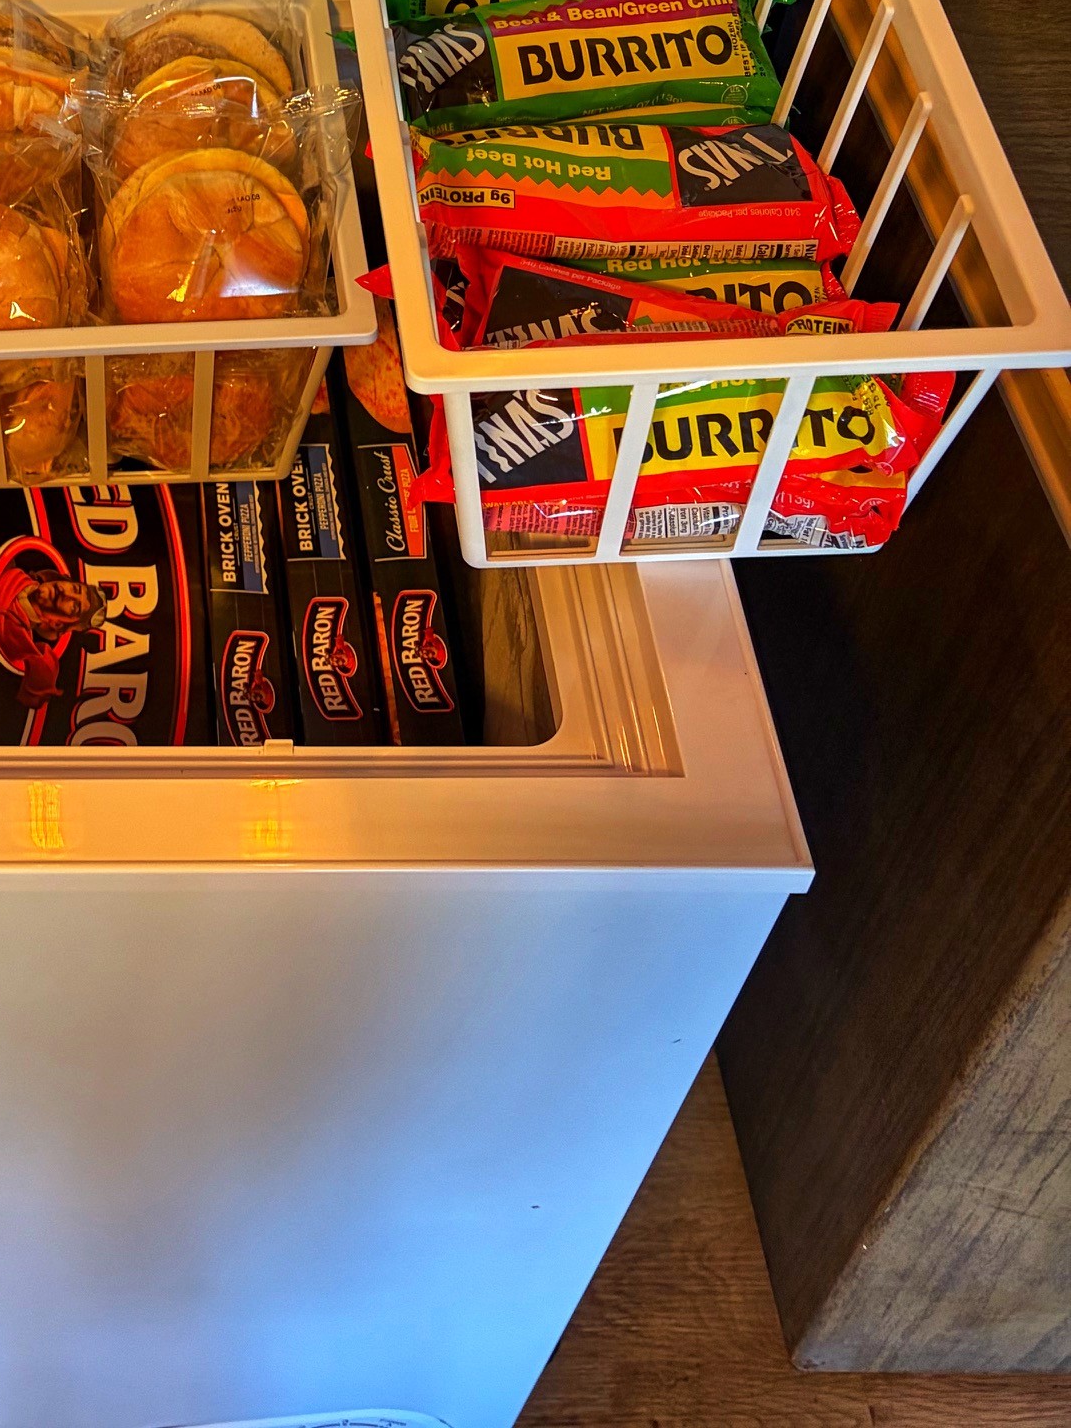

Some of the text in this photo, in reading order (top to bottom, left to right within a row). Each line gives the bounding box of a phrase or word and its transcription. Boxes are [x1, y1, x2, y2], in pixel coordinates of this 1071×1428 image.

[545, 10, 563, 22] &
[567, 0, 683, 22] Bean/Green
[517, 25, 733, 86] BURRITO
[466, 147, 611, 181] Red Hot Beef
[420, 186, 511, 204] 9g PROTEIN
[698, 207, 801, 219] 340 Calories per Package
[571, 271, 585, 282] per
[586, 275, 622, 291] Package
[607, 259, 653, 273] Red
[613, 404, 876, 465] URRTO
[313, 471, 329, 531] PEPPERONI PIZZA
[373, 451, 406, 552] Classic Crust
[399, 468, 412, 489] PIZZA
[215, 482, 237, 583] BRICK OVEN
[239, 503, 254, 564] PEPPERONI PIZZA
[293, 501, 314, 552] BRICK
[680, 507, 688, 520] Iron
[70, 564, 159, 746] BARO
[311, 606, 349, 712] RED BARON
[400, 598, 440, 704] RED BARON
[229, 639, 263, 747] RED BARON
